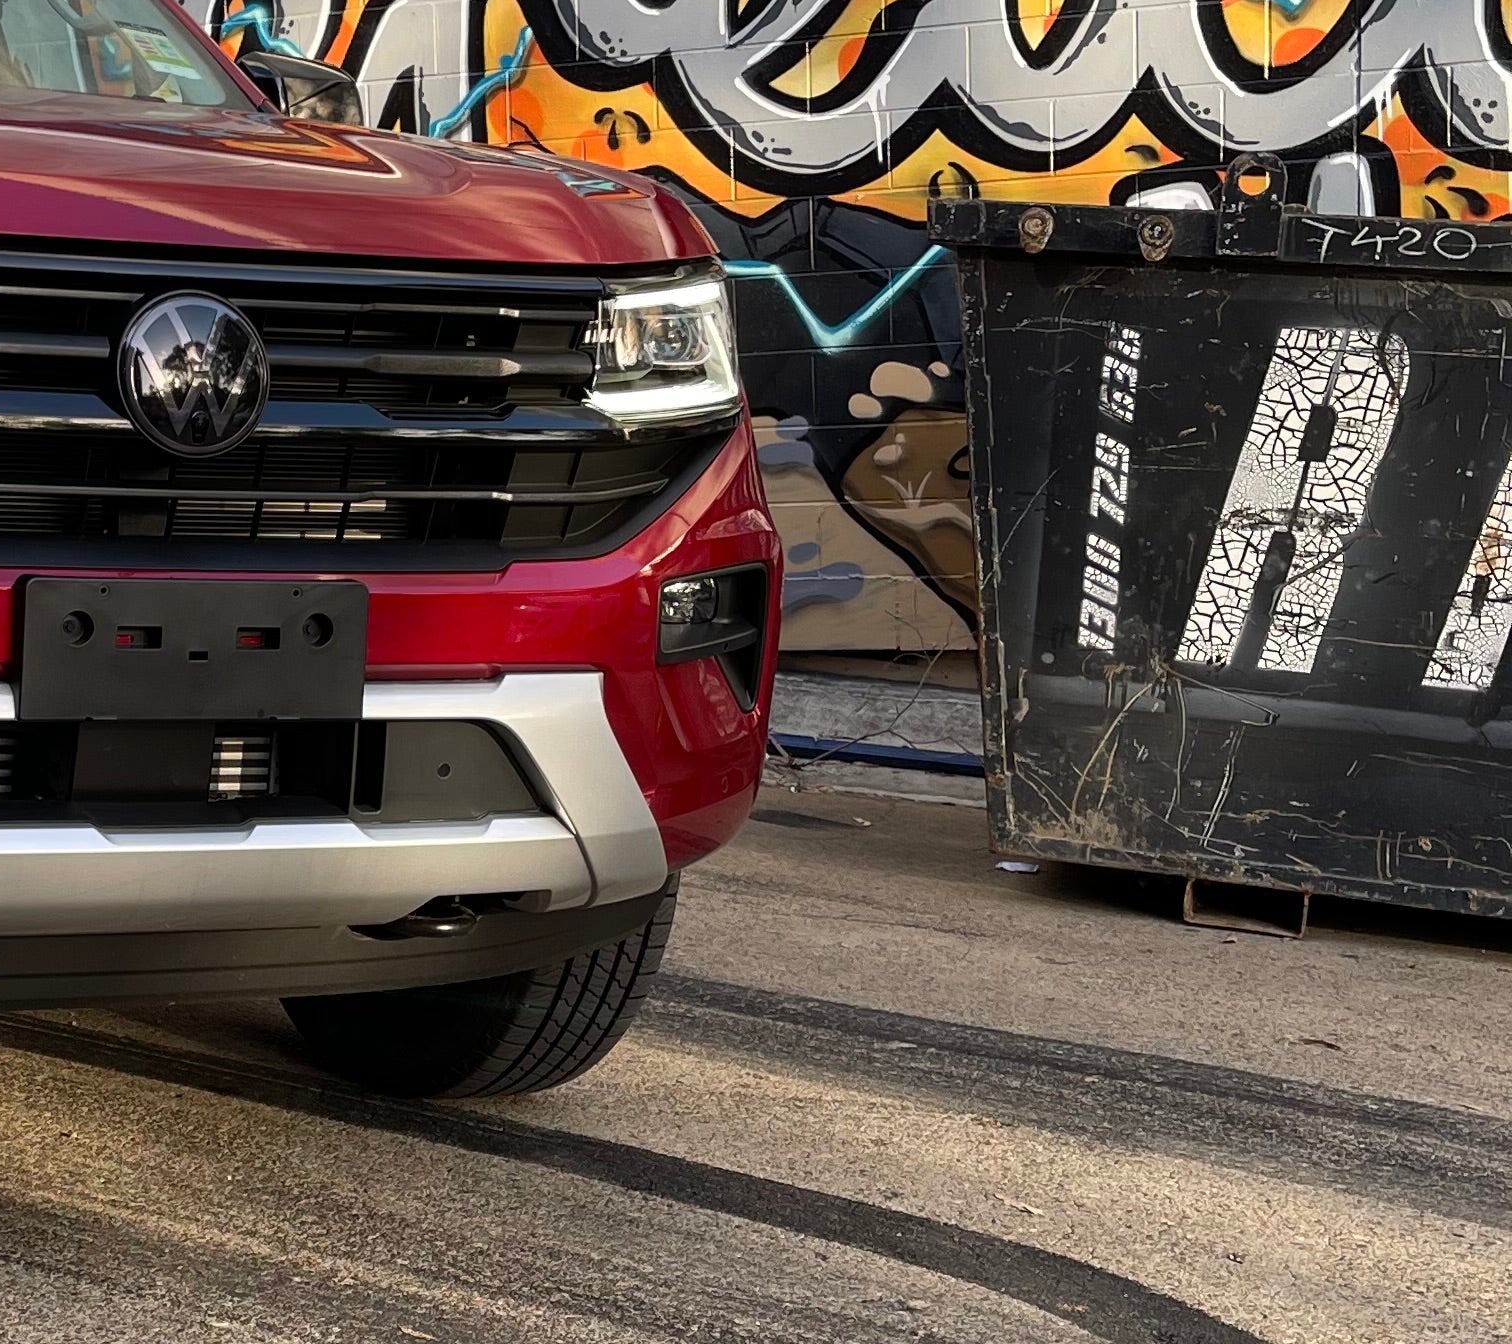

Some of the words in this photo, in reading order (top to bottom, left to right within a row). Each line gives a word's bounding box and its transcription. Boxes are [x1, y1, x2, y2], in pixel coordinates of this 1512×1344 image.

[1301, 218, 1477, 263] T420
[1090, 432, 1130, 525] 729
[1078, 532, 1122, 655] 1300
